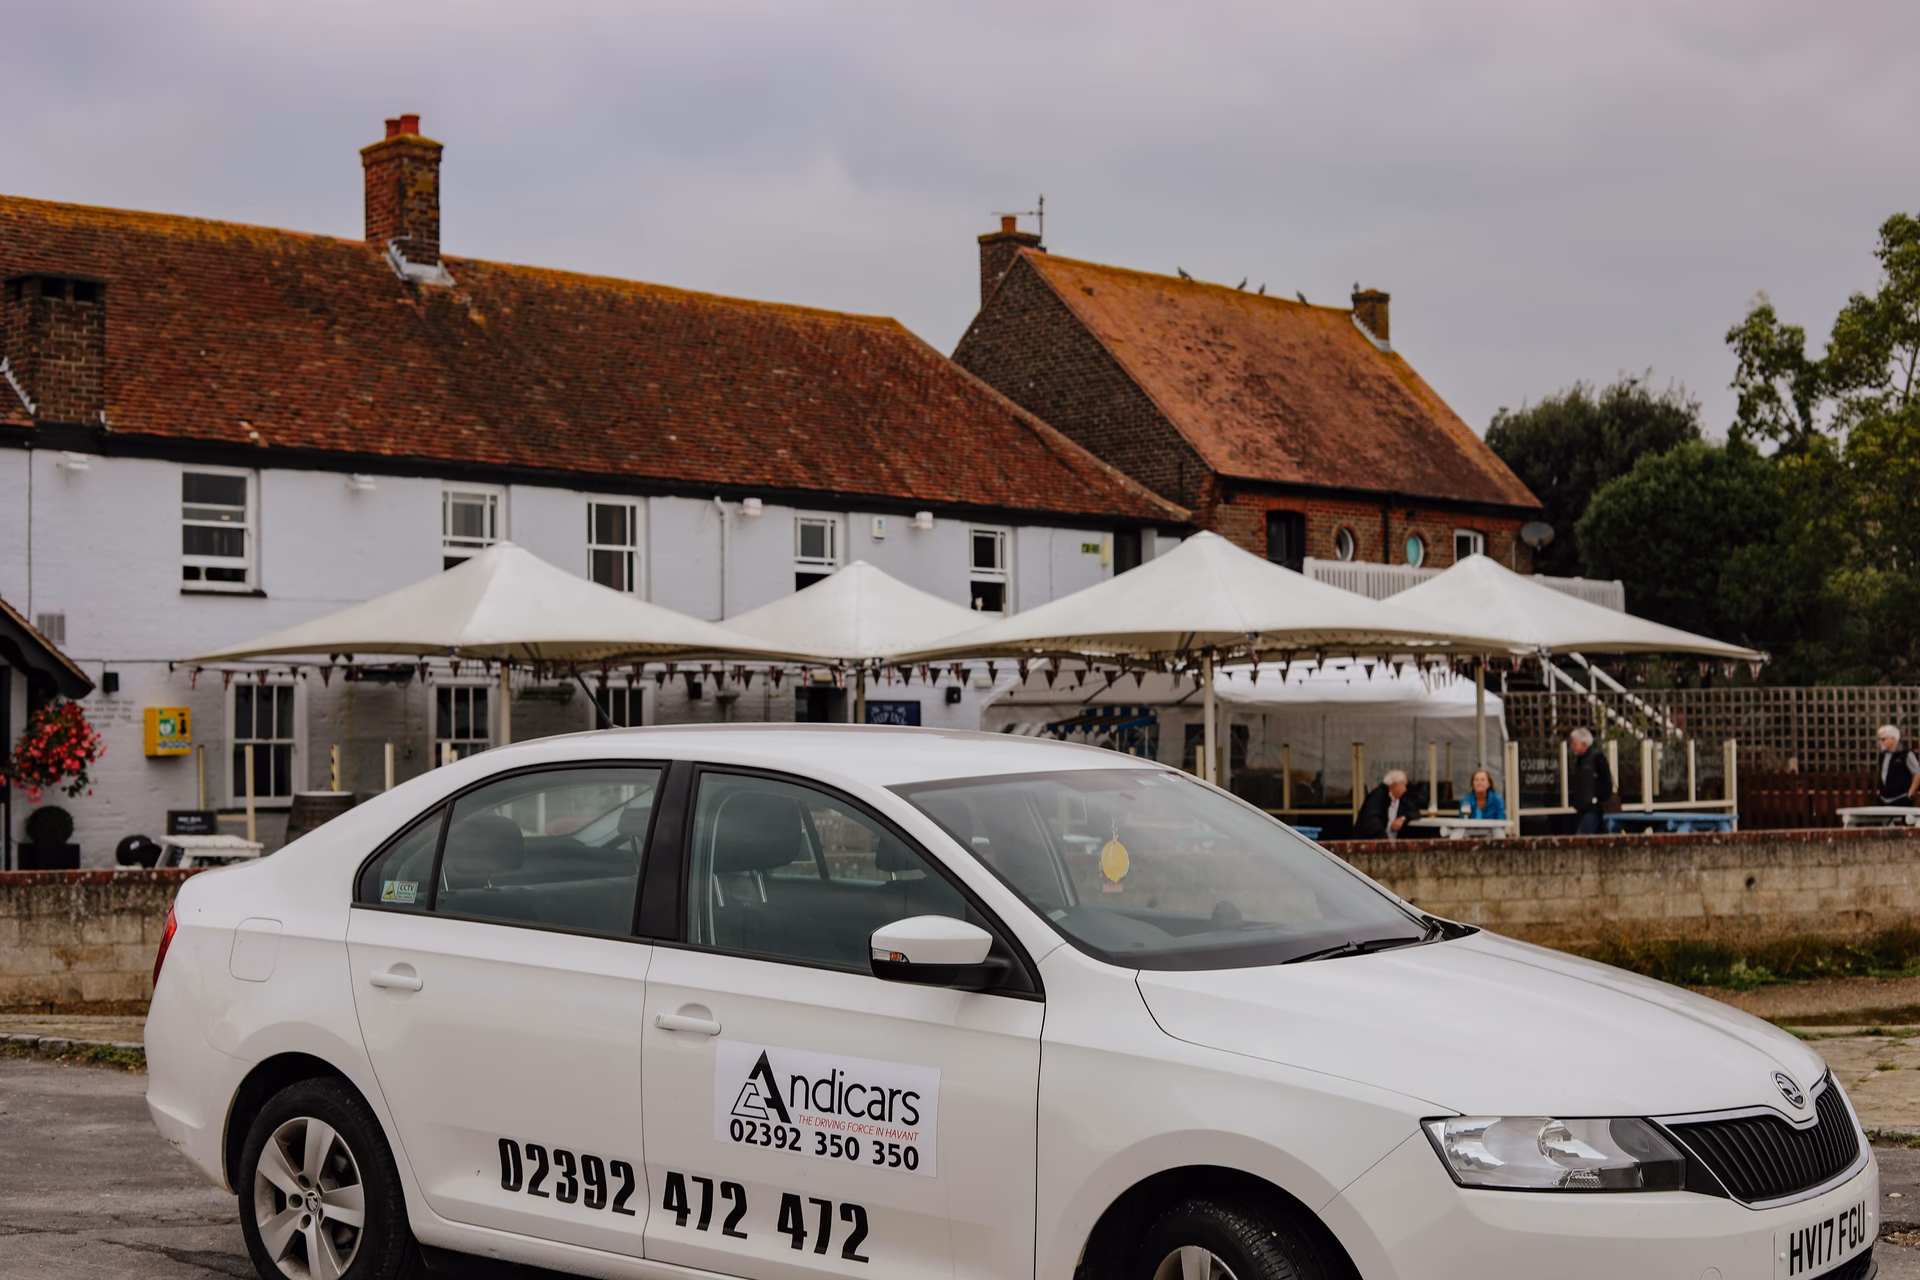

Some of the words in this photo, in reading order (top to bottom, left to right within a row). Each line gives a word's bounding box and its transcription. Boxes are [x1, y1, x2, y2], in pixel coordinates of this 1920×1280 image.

[731, 1049, 921, 1126] Andicars
[729, 1118, 802, 1152] 02392
[814, 1131, 860, 1161] 350
[872, 1140, 919, 1171] 350
[798, 1114, 814, 1126] THE
[814, 1117, 846, 1131] DRIVING
[847, 1122, 875, 1136] FORCE
[875, 1126, 885, 1137] IN
[885, 1128, 920, 1142] HAVANT
[498, 1138, 636, 1217] 02392
[662, 1171, 748, 1240] 472
[777, 1192, 870, 1264] 472
[1789, 1217, 1835, 1277] HV17
[1838, 1200, 1866, 1256] FGU
